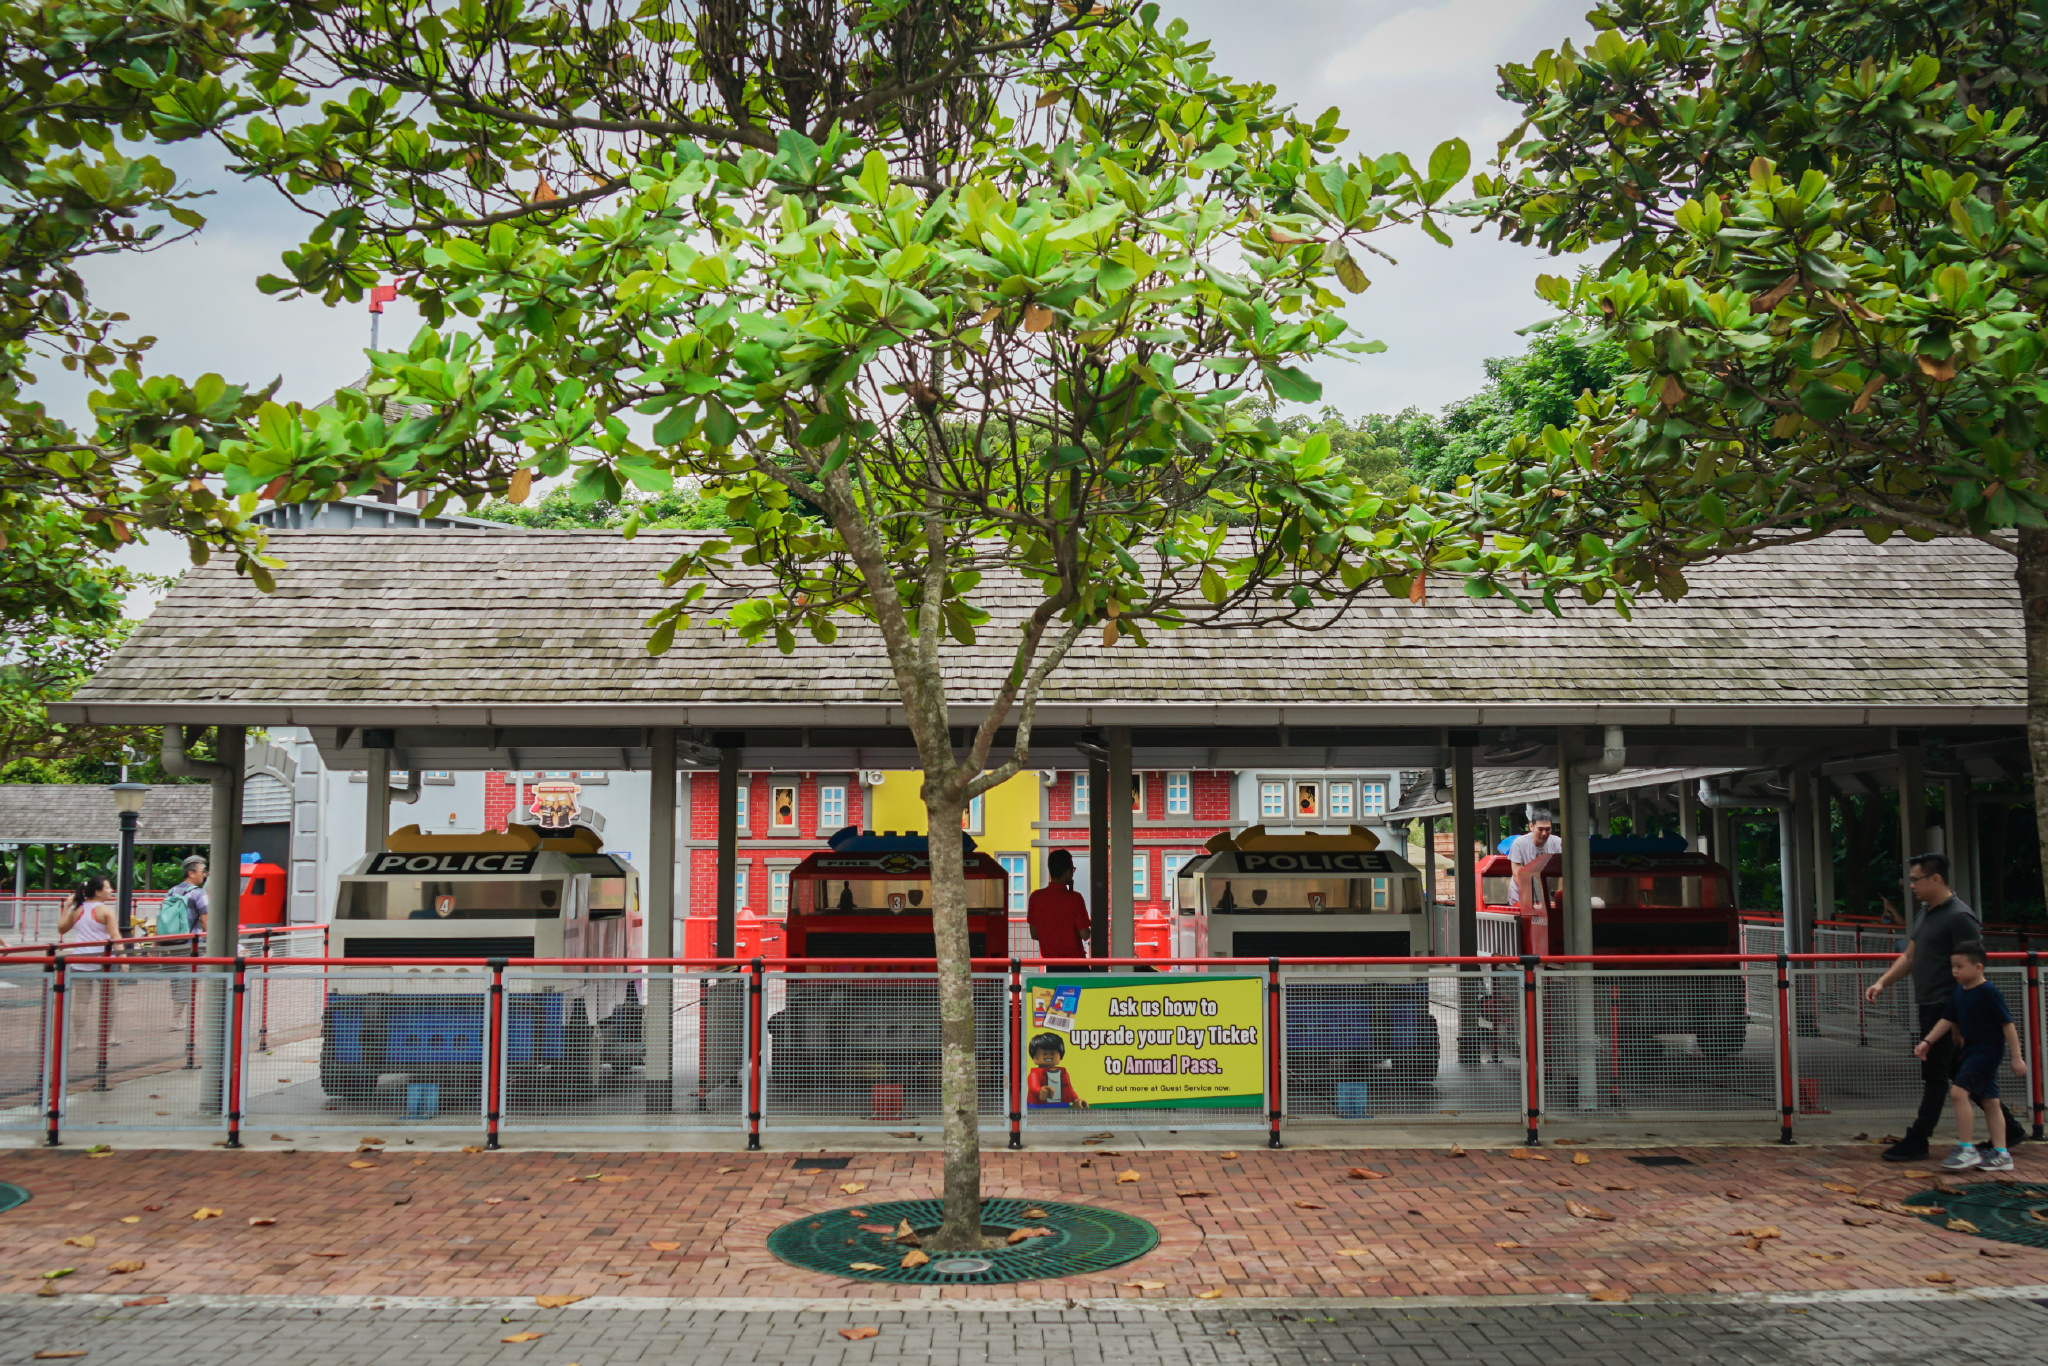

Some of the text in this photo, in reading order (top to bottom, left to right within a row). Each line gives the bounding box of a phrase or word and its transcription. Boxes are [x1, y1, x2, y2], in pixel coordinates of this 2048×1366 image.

[377, 855, 528, 872] POLICE
[1244, 854, 1383, 870] POLICE
[439, 898, 450, 912] 4
[893, 896, 901, 910] 3
[1313, 895, 1322, 908] 2
[1109, 997, 1218, 1016] Ask us how to
[1070, 1026, 1257, 1050] upgrade your Day Ticket
[1105, 1055, 1223, 1075] to Annual Pass.
